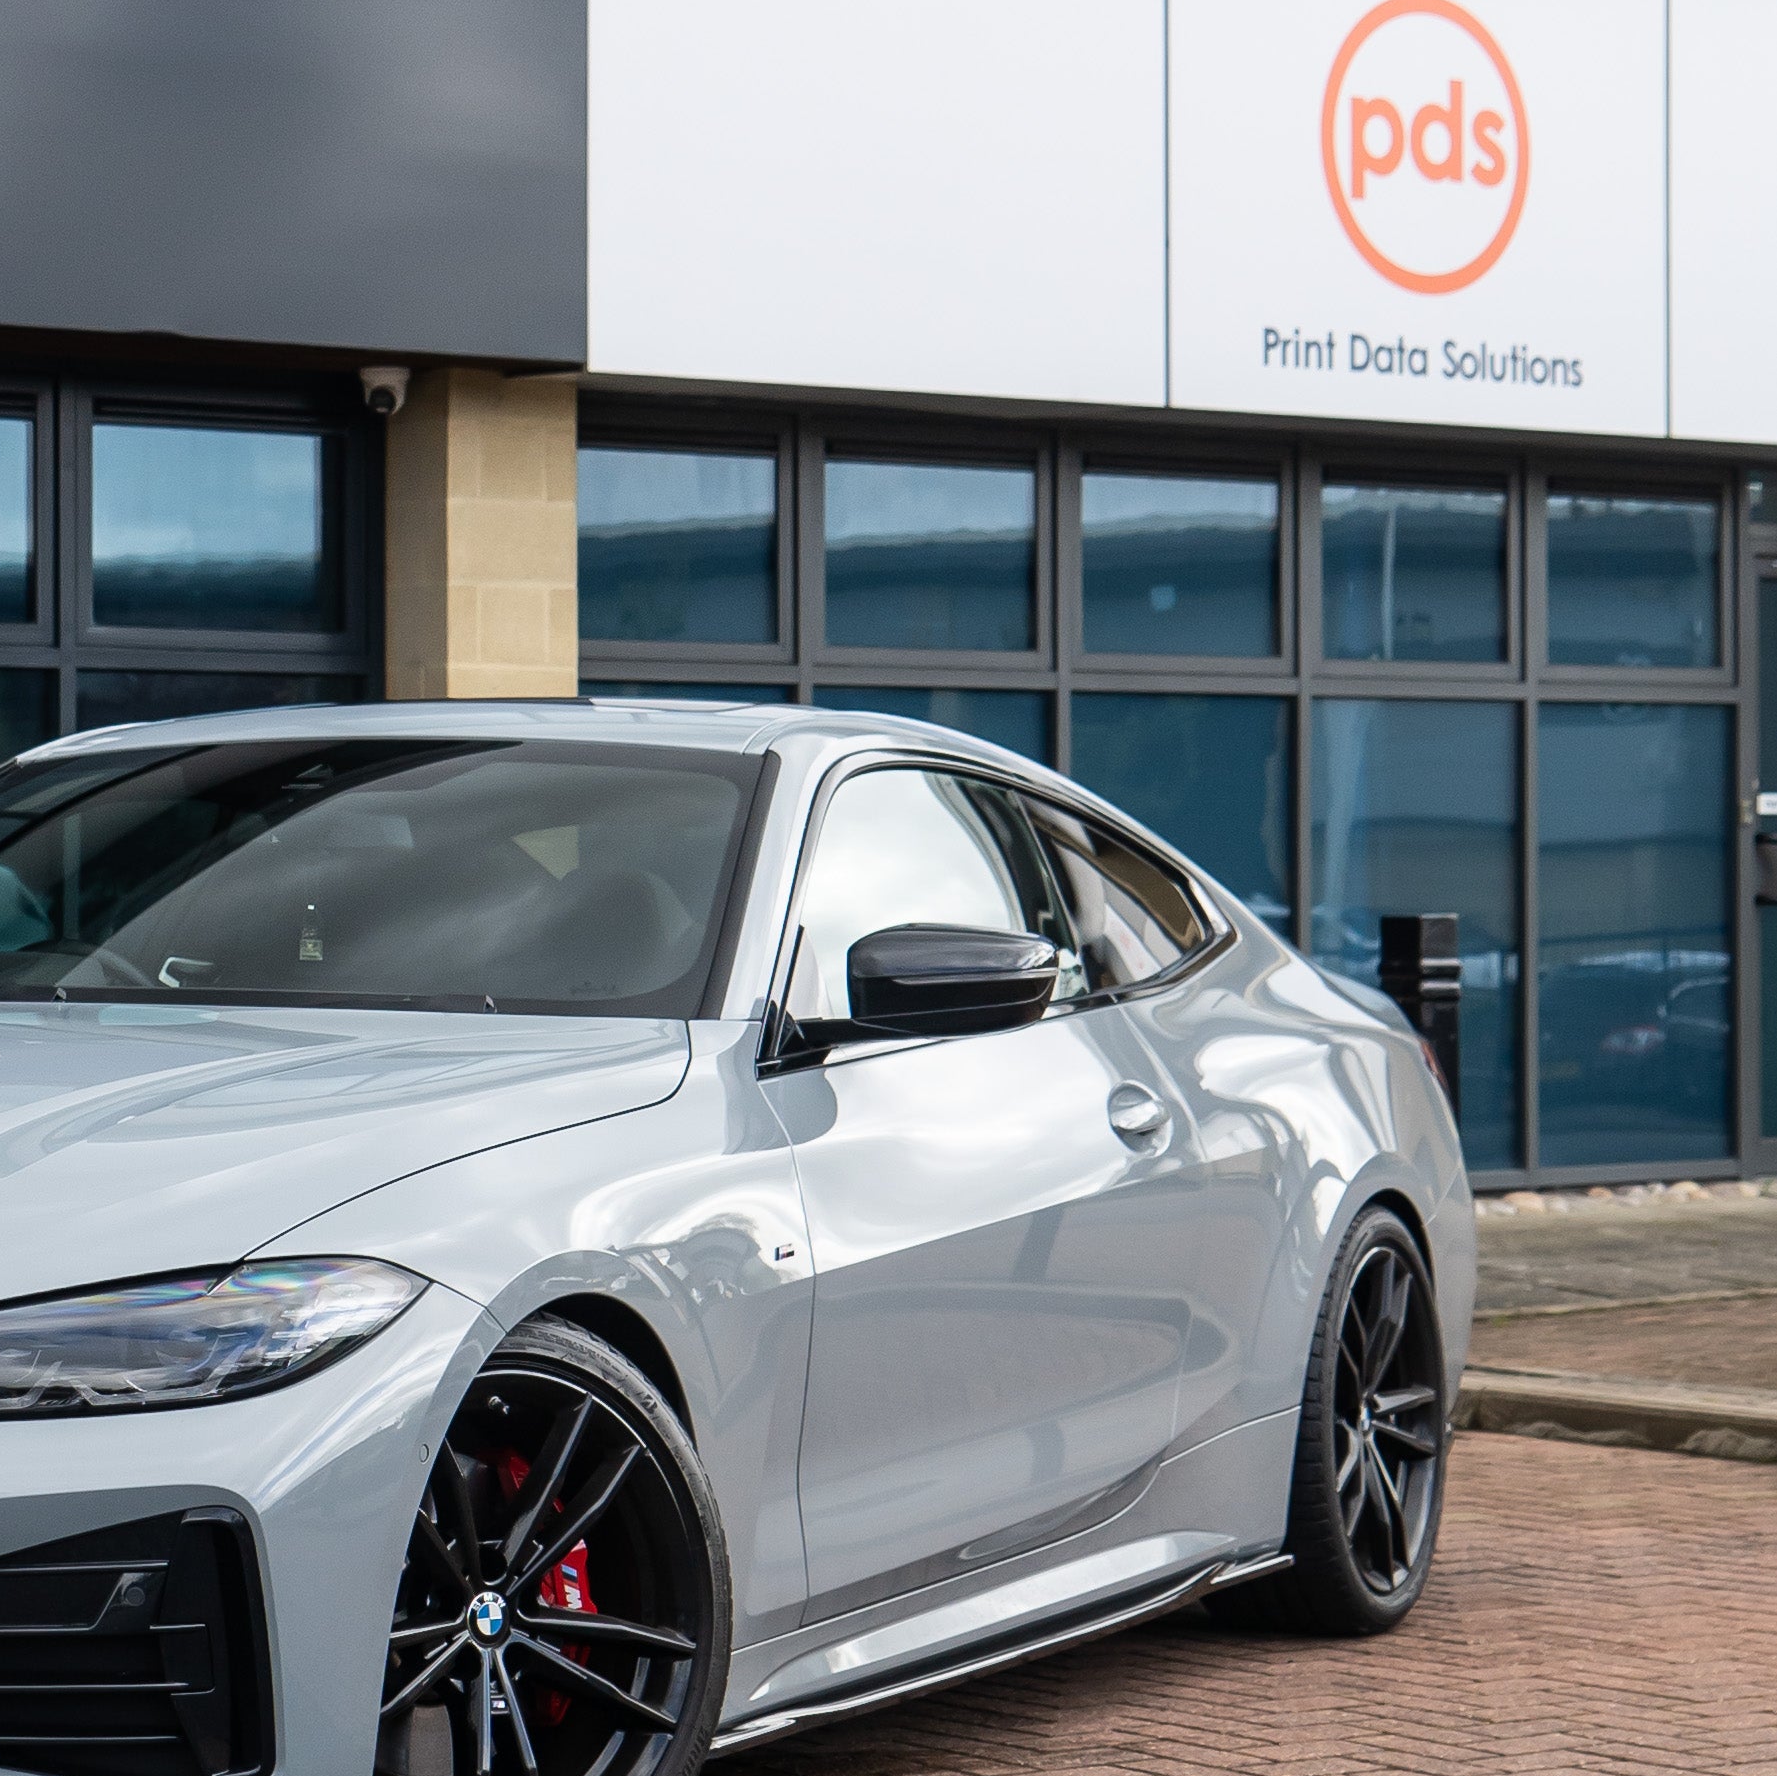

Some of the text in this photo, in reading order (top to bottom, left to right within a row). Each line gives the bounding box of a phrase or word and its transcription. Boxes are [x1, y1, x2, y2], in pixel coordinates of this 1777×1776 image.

[1351, 80, 1507, 200] pds
[1263, 327, 1583, 388] Print Data Solutions
